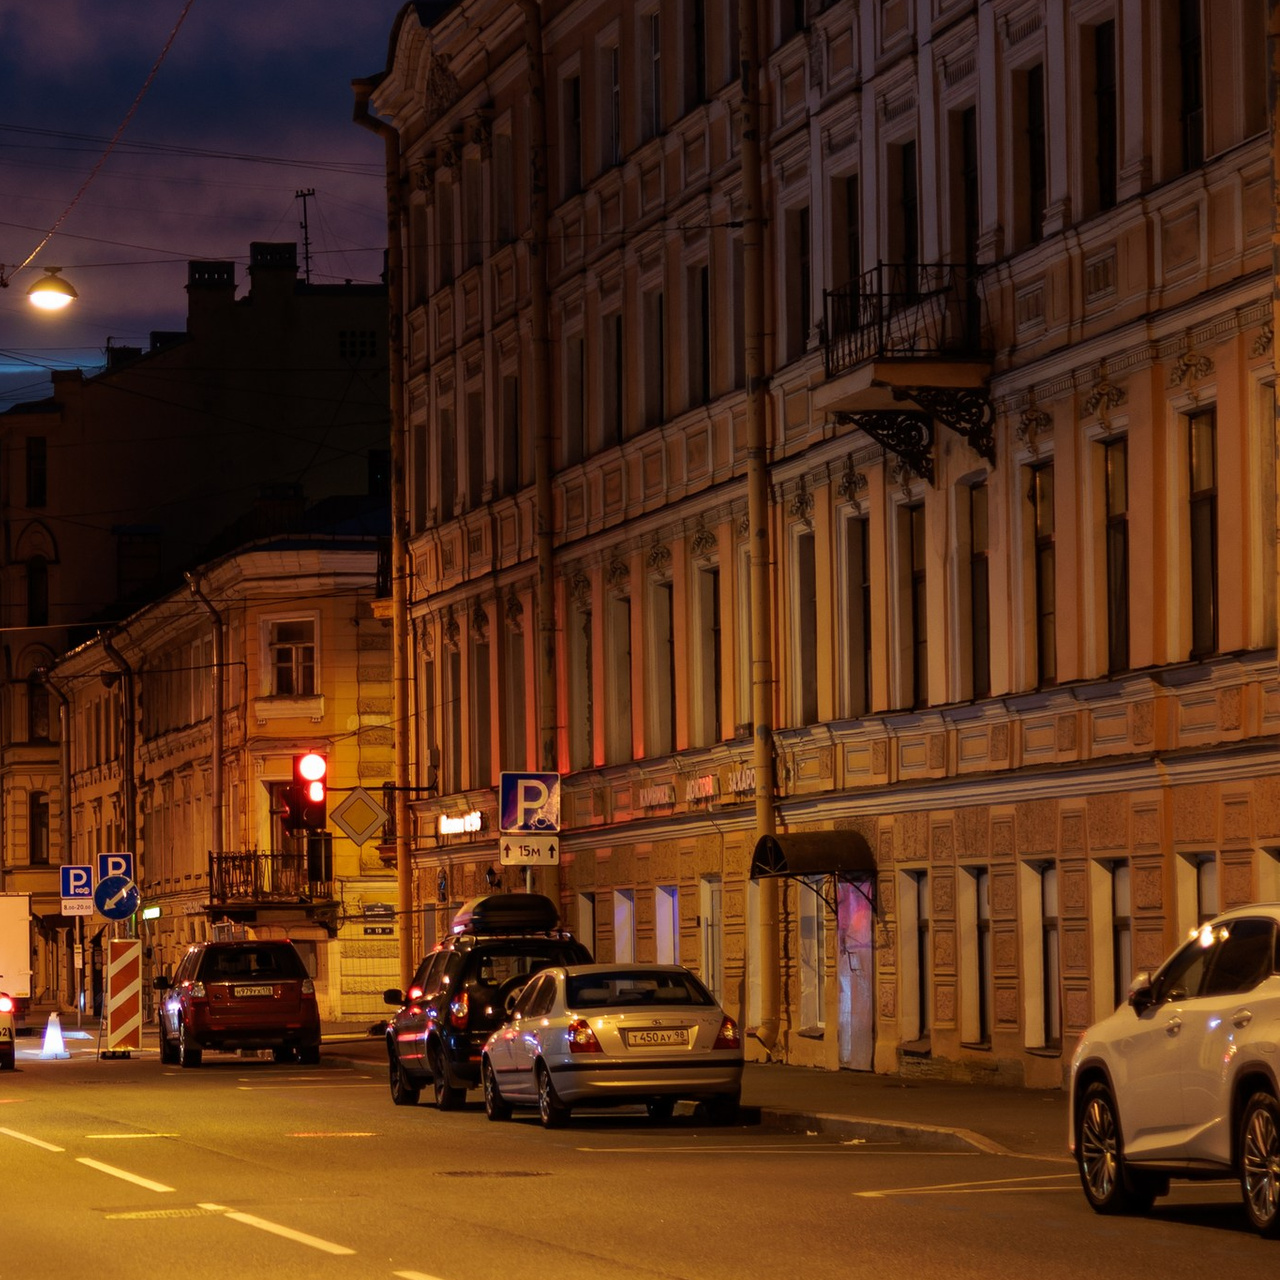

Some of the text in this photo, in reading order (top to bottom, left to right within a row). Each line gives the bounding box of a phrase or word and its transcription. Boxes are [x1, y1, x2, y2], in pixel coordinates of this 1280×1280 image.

[729, 769, 756, 792] ЗАХАРО
[517, 779, 549, 826] P
[107, 857, 127, 876] P
[69, 869, 87, 895] P
